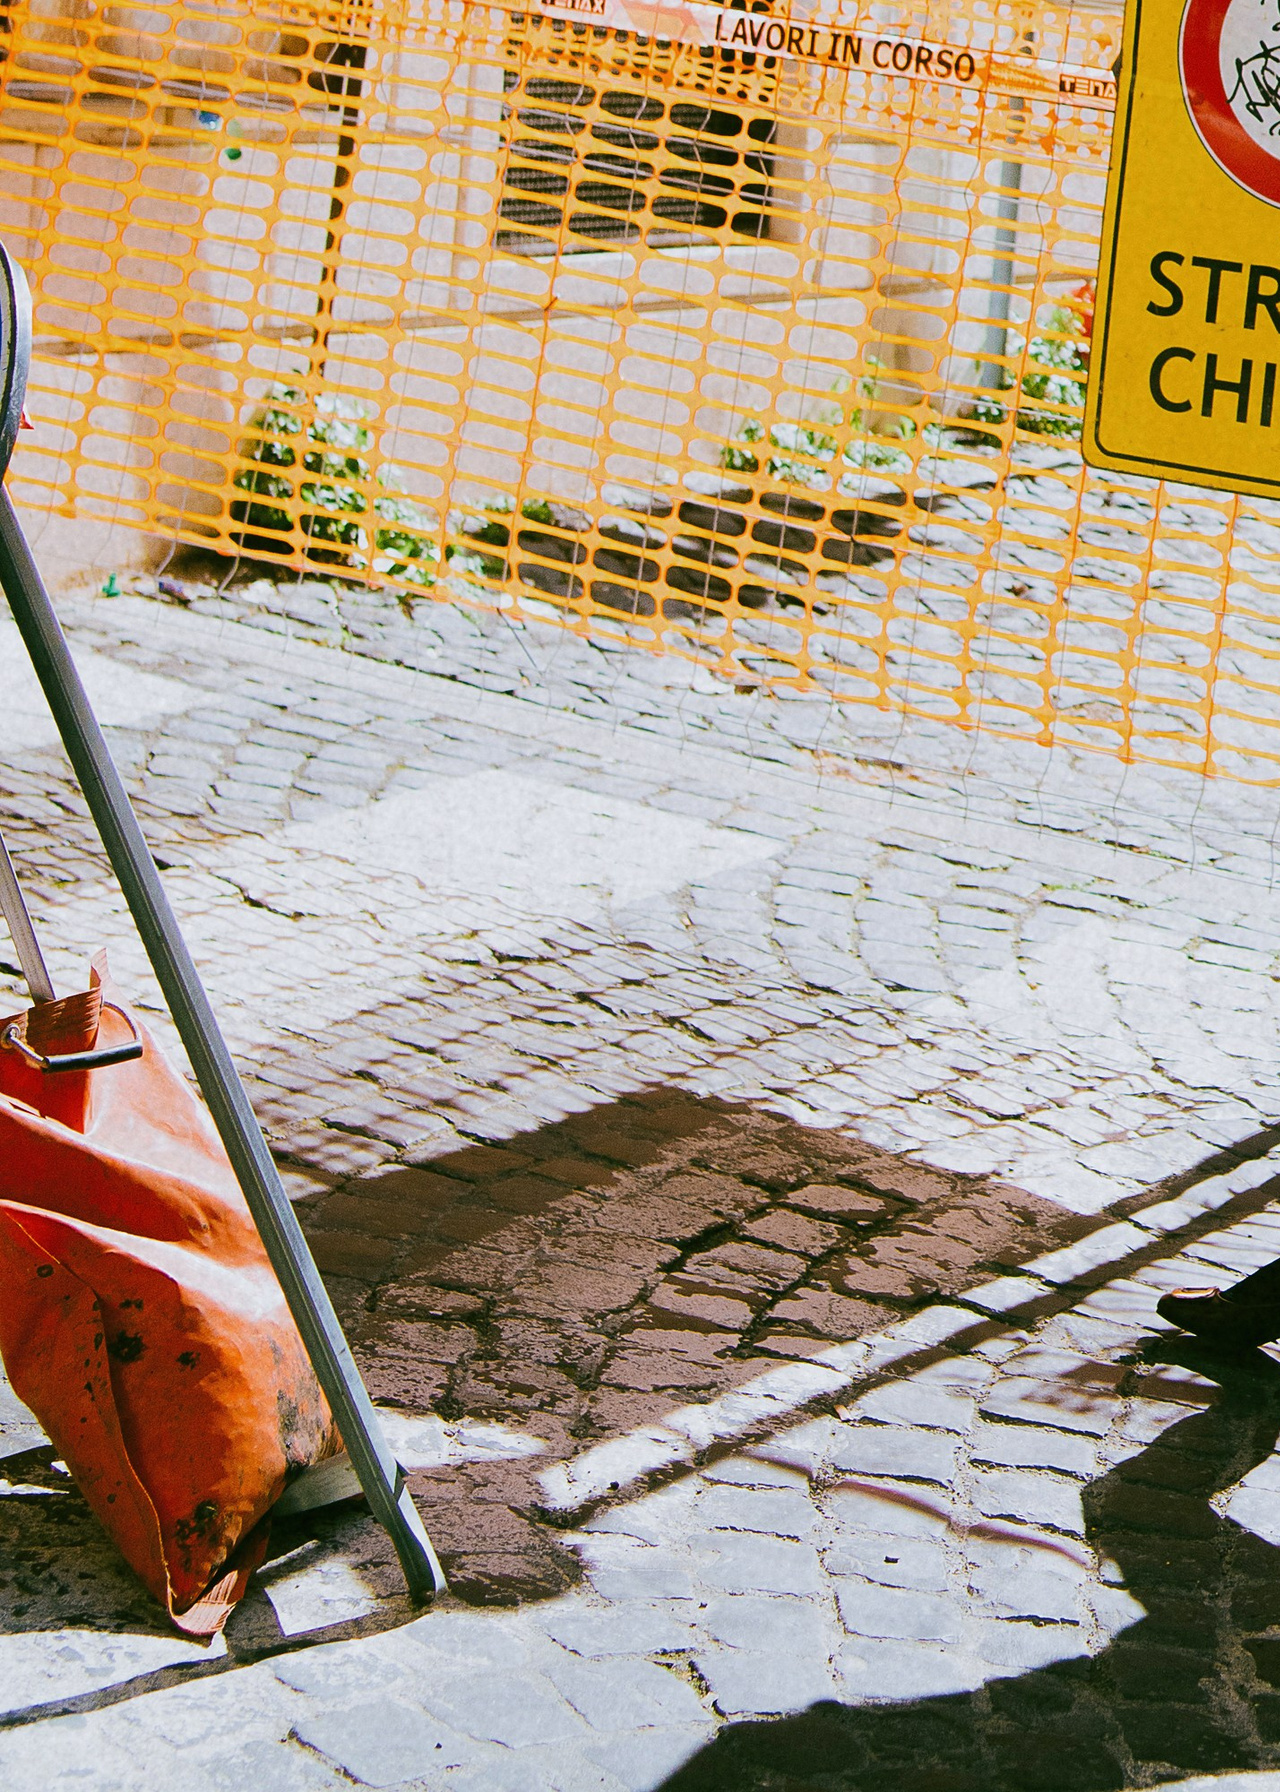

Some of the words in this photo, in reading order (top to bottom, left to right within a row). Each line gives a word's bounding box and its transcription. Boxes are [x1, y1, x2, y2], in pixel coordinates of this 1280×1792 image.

[715, 13, 819, 59] LAVORI
[827, 33, 861, 65] IN
[872, 39, 975, 84] CORSO
[1061, 74, 1117, 98] TENA
